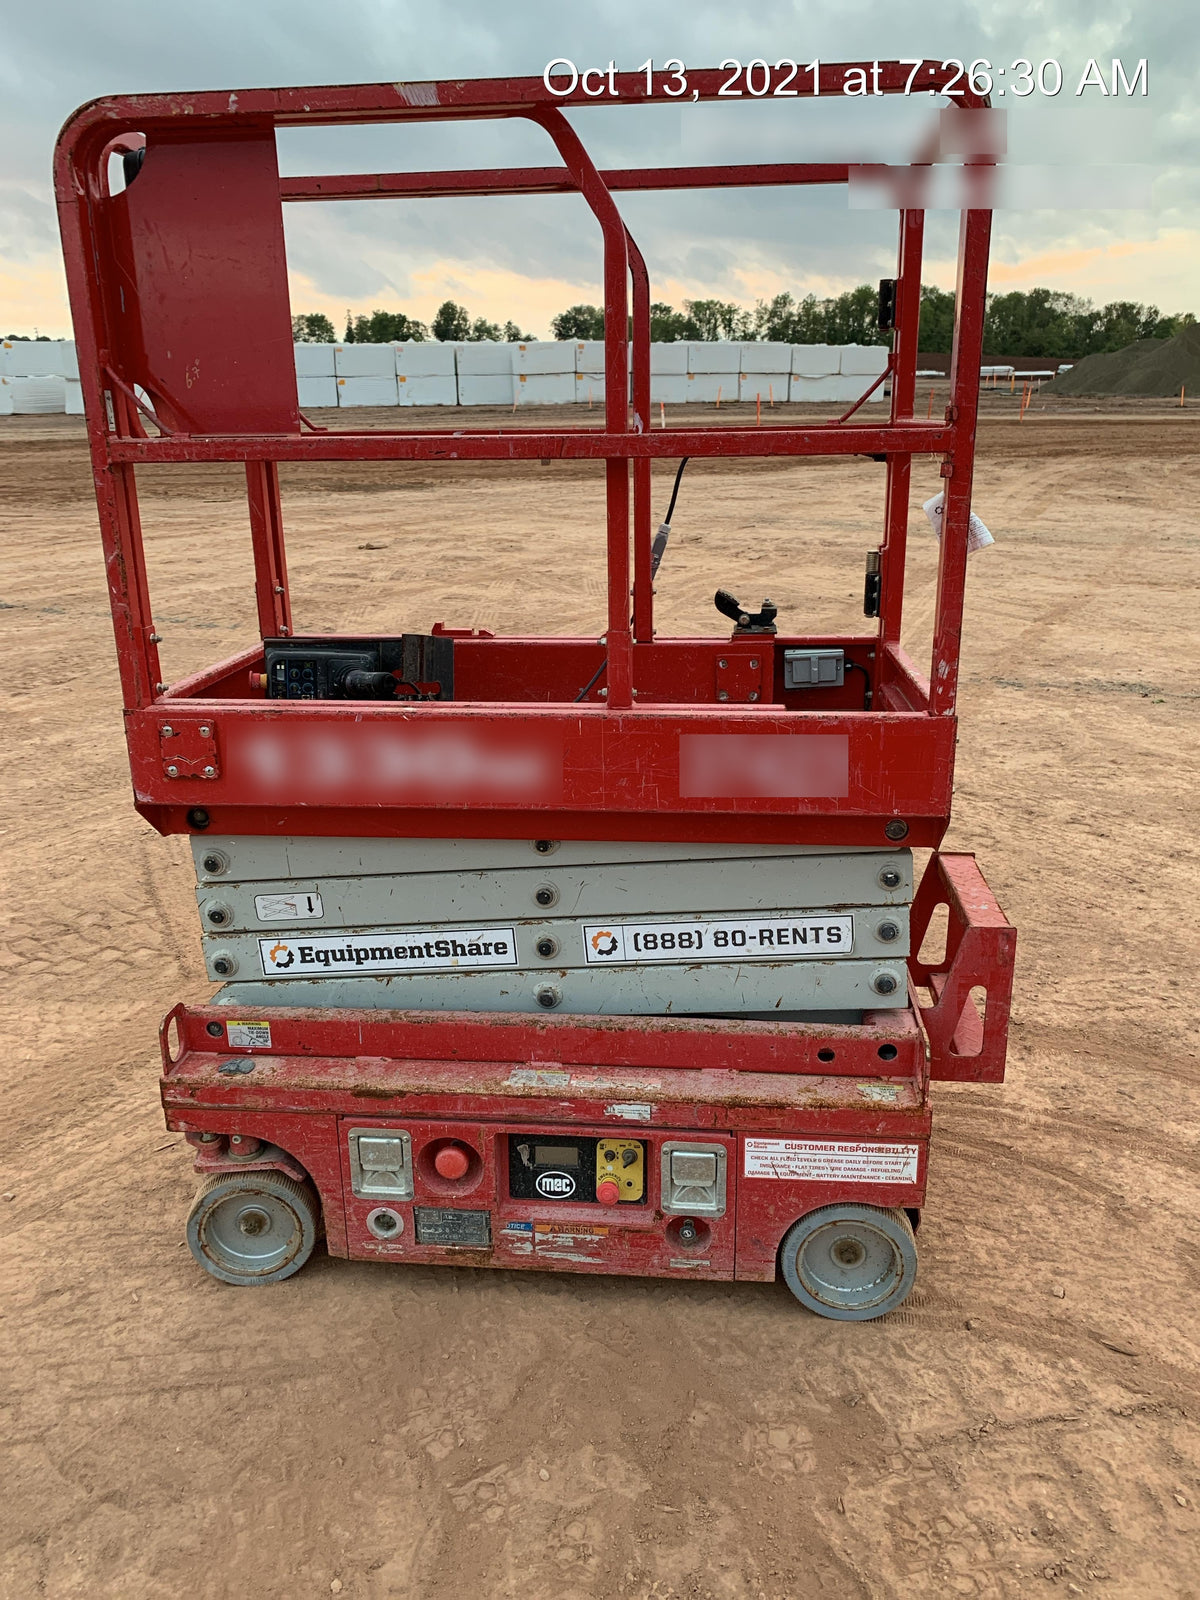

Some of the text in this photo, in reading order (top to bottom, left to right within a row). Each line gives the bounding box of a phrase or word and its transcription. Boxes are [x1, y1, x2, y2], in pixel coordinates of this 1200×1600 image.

[633, 925, 843, 952] (888) 80-RENTS
[297, 939, 509, 968] EquipmentShare
[784, 1143, 917, 1154] CUSTOMER RESPONSIBILITY
[506, 1222, 525, 1230] OTICE
